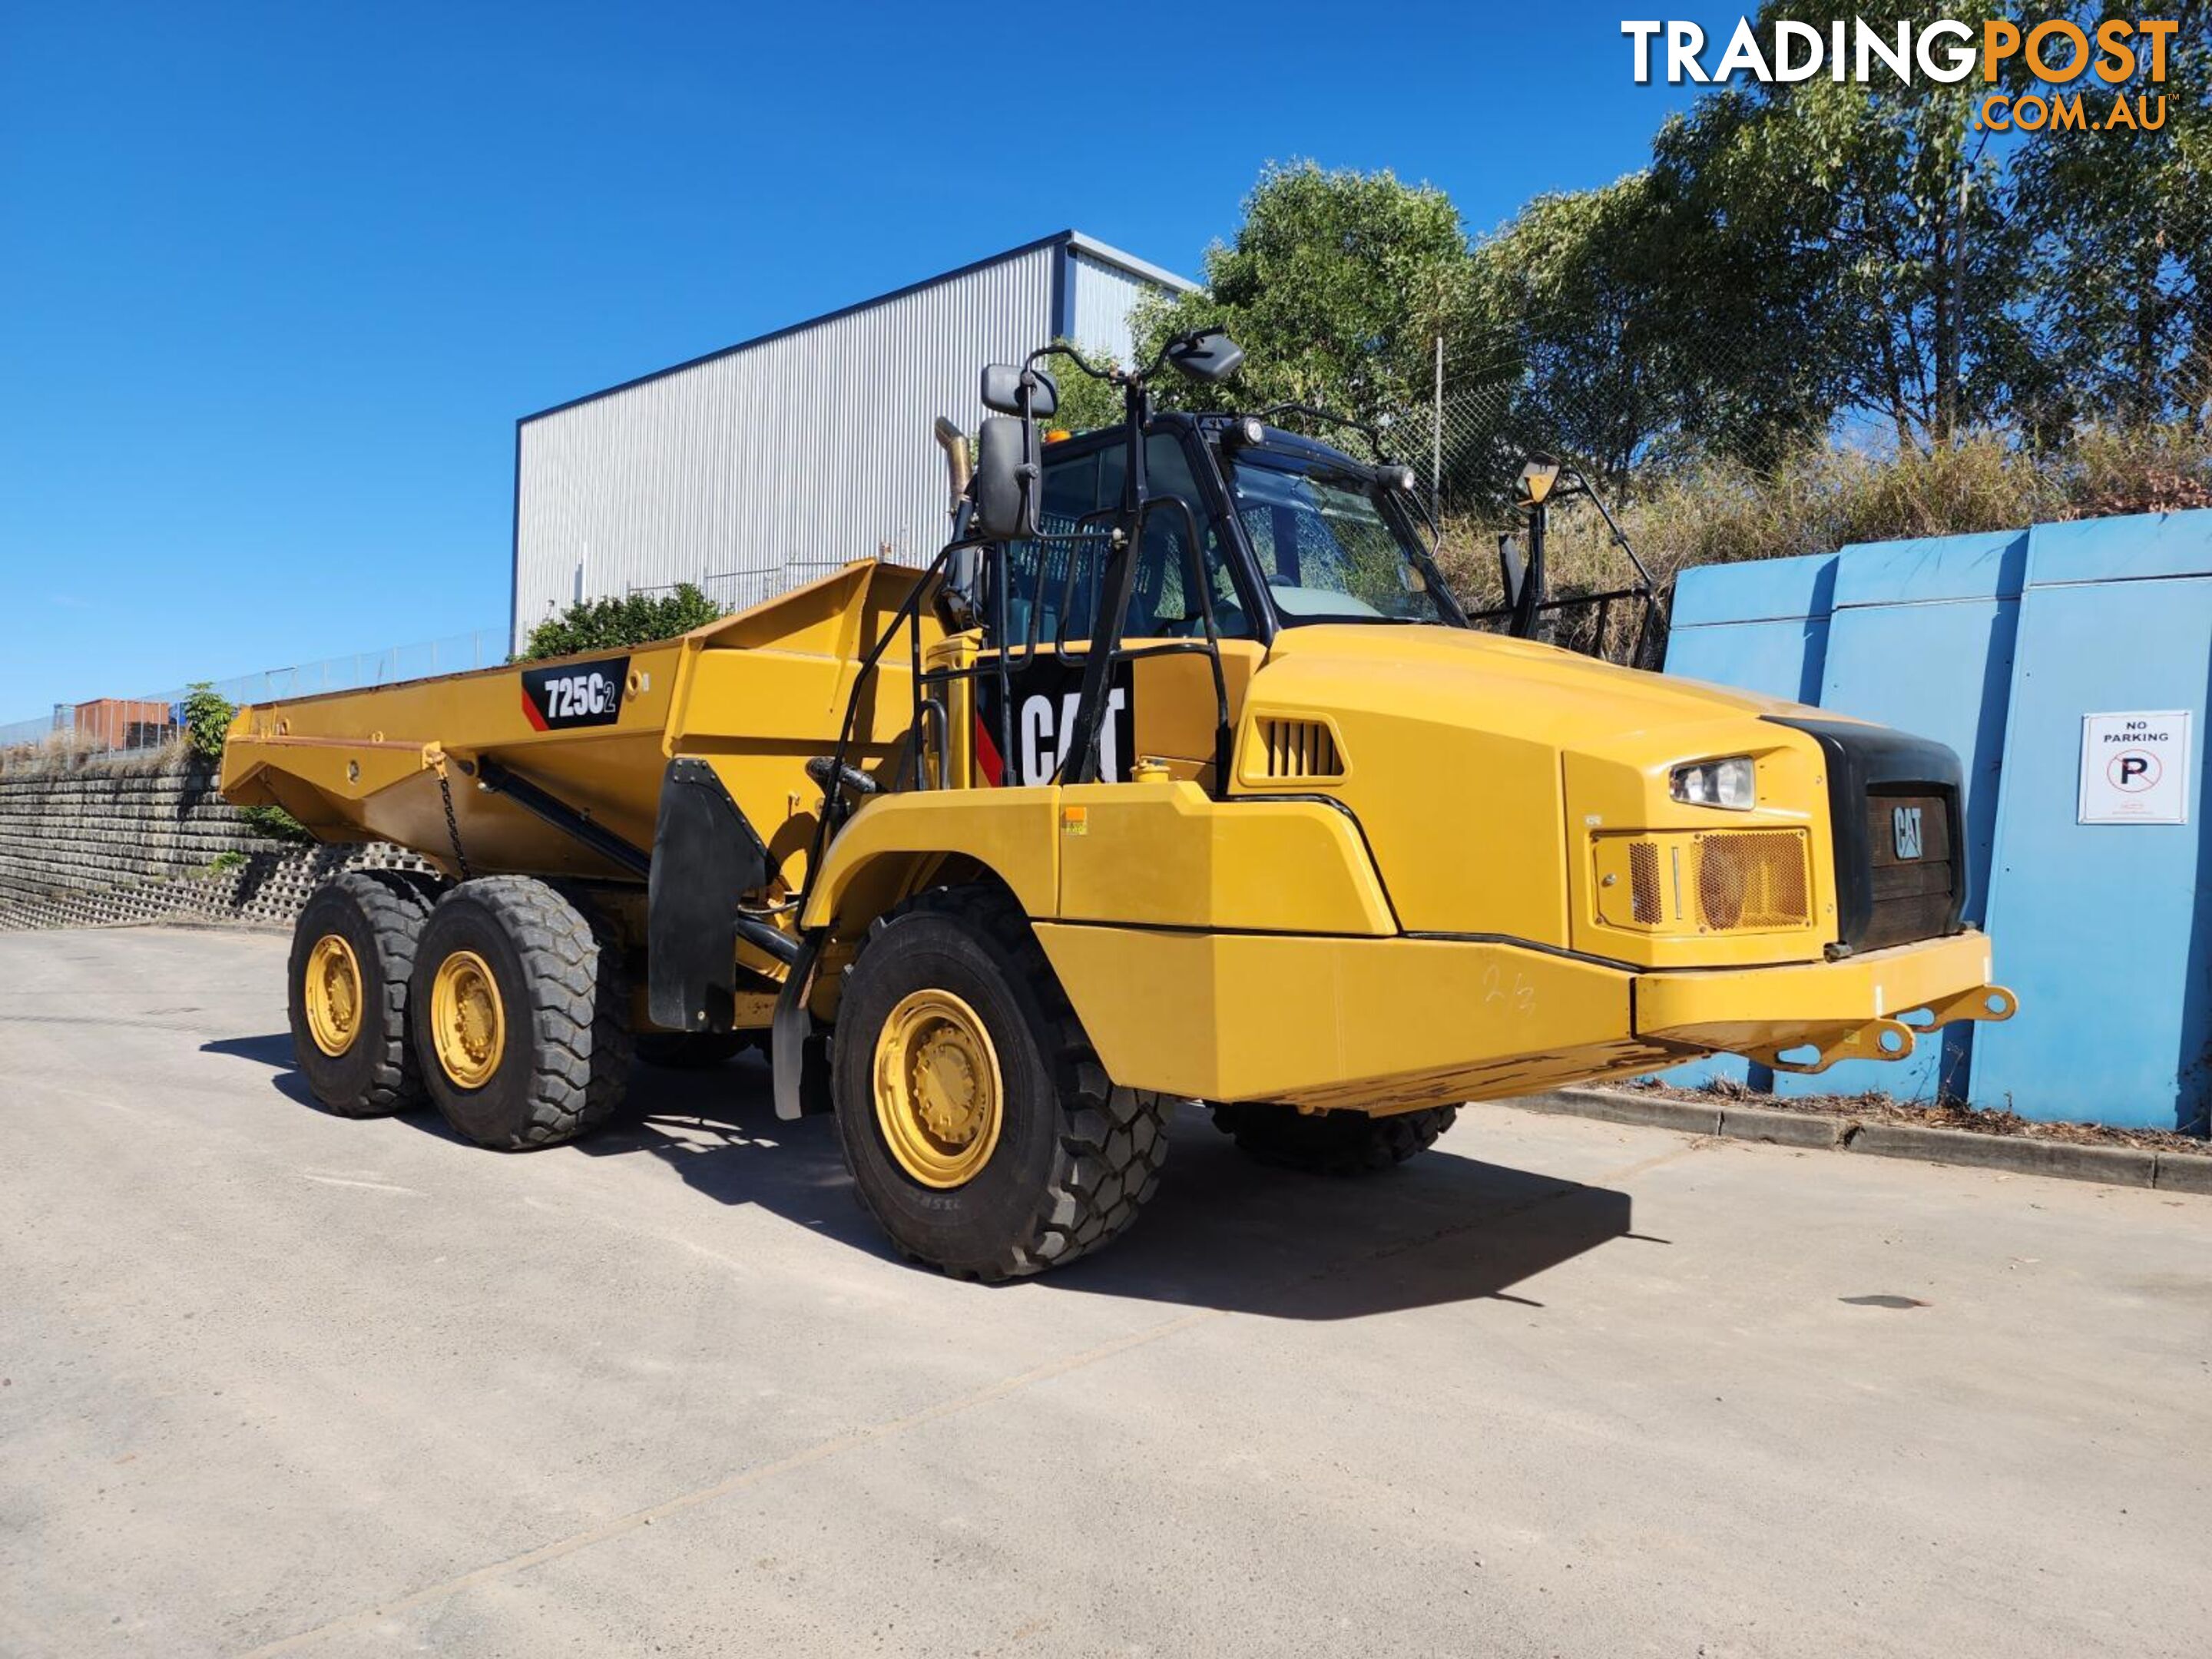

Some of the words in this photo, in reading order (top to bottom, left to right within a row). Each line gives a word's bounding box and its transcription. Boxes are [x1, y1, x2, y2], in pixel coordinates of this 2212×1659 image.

[2126, 721, 2147, 730] NO
[2103, 733, 2169, 743] PARKING
[2121, 757, 2147, 784] P
[1893, 806, 1922, 859] CAT
